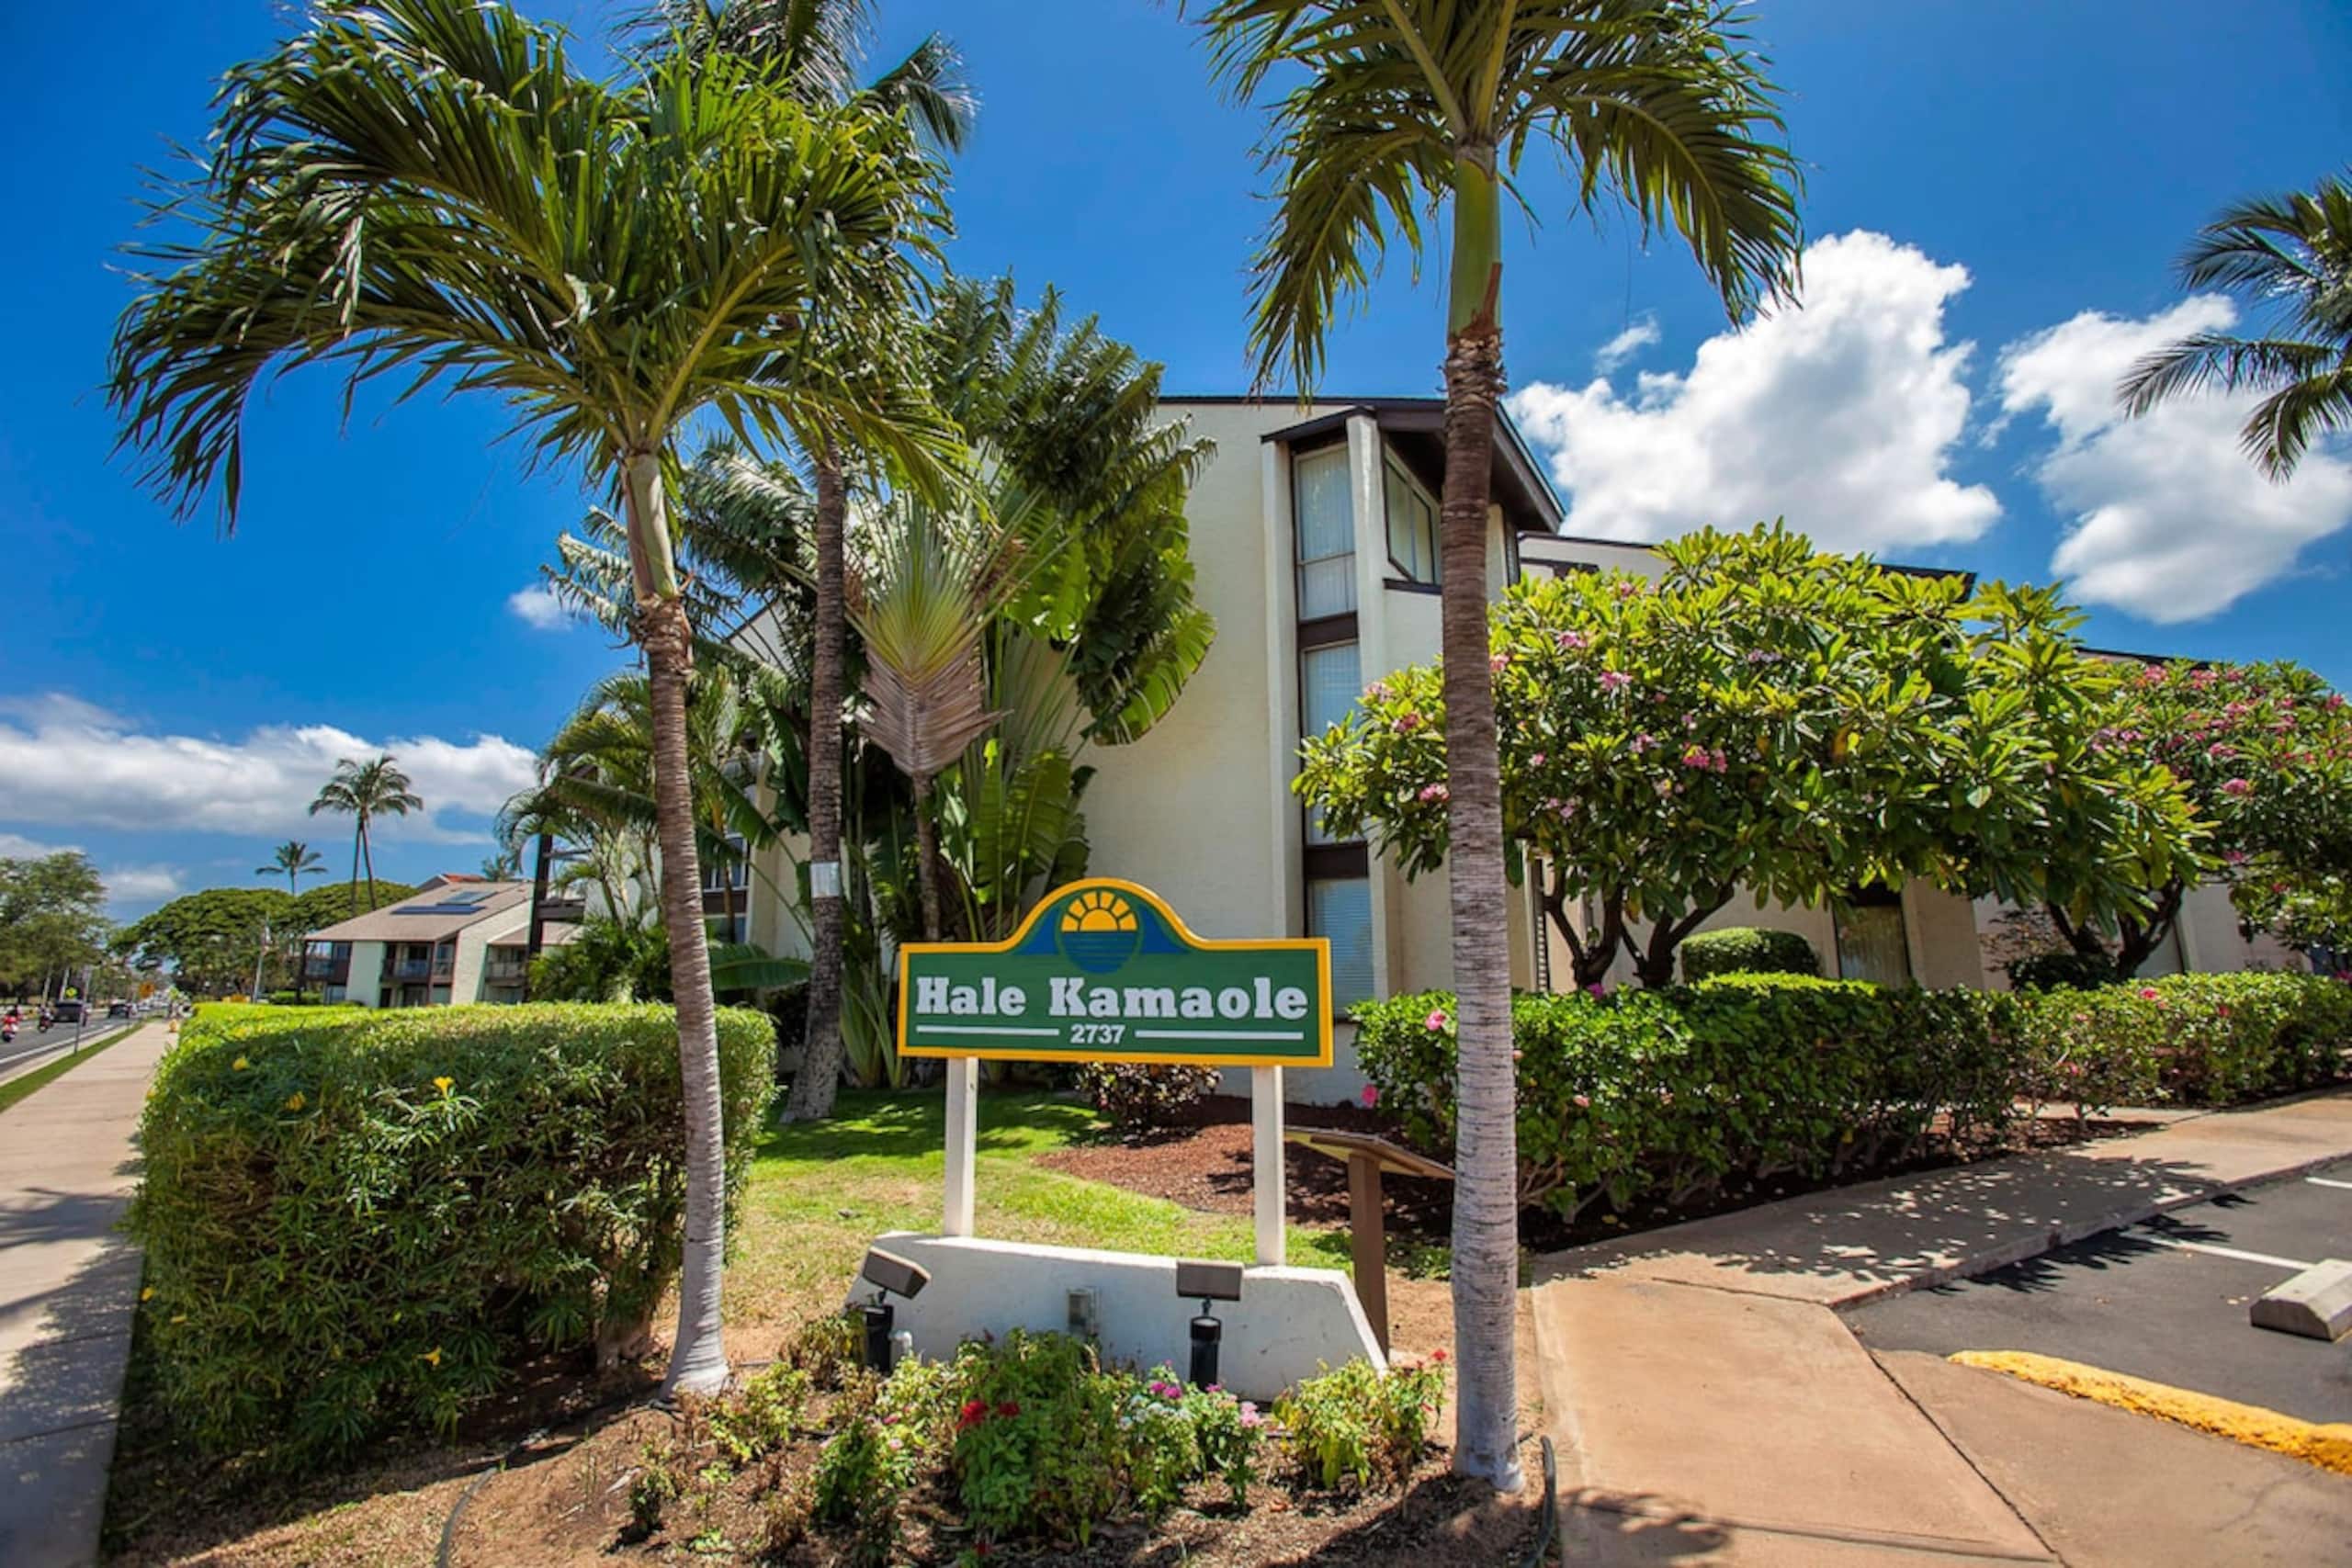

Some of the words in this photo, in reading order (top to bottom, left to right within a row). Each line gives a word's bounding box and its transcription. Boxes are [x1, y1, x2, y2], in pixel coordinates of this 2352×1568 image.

[916, 977, 1026, 1016] Hale
[1048, 977, 1308, 1019] Kamaole
[1069, 1024, 1126, 1044] 2737
